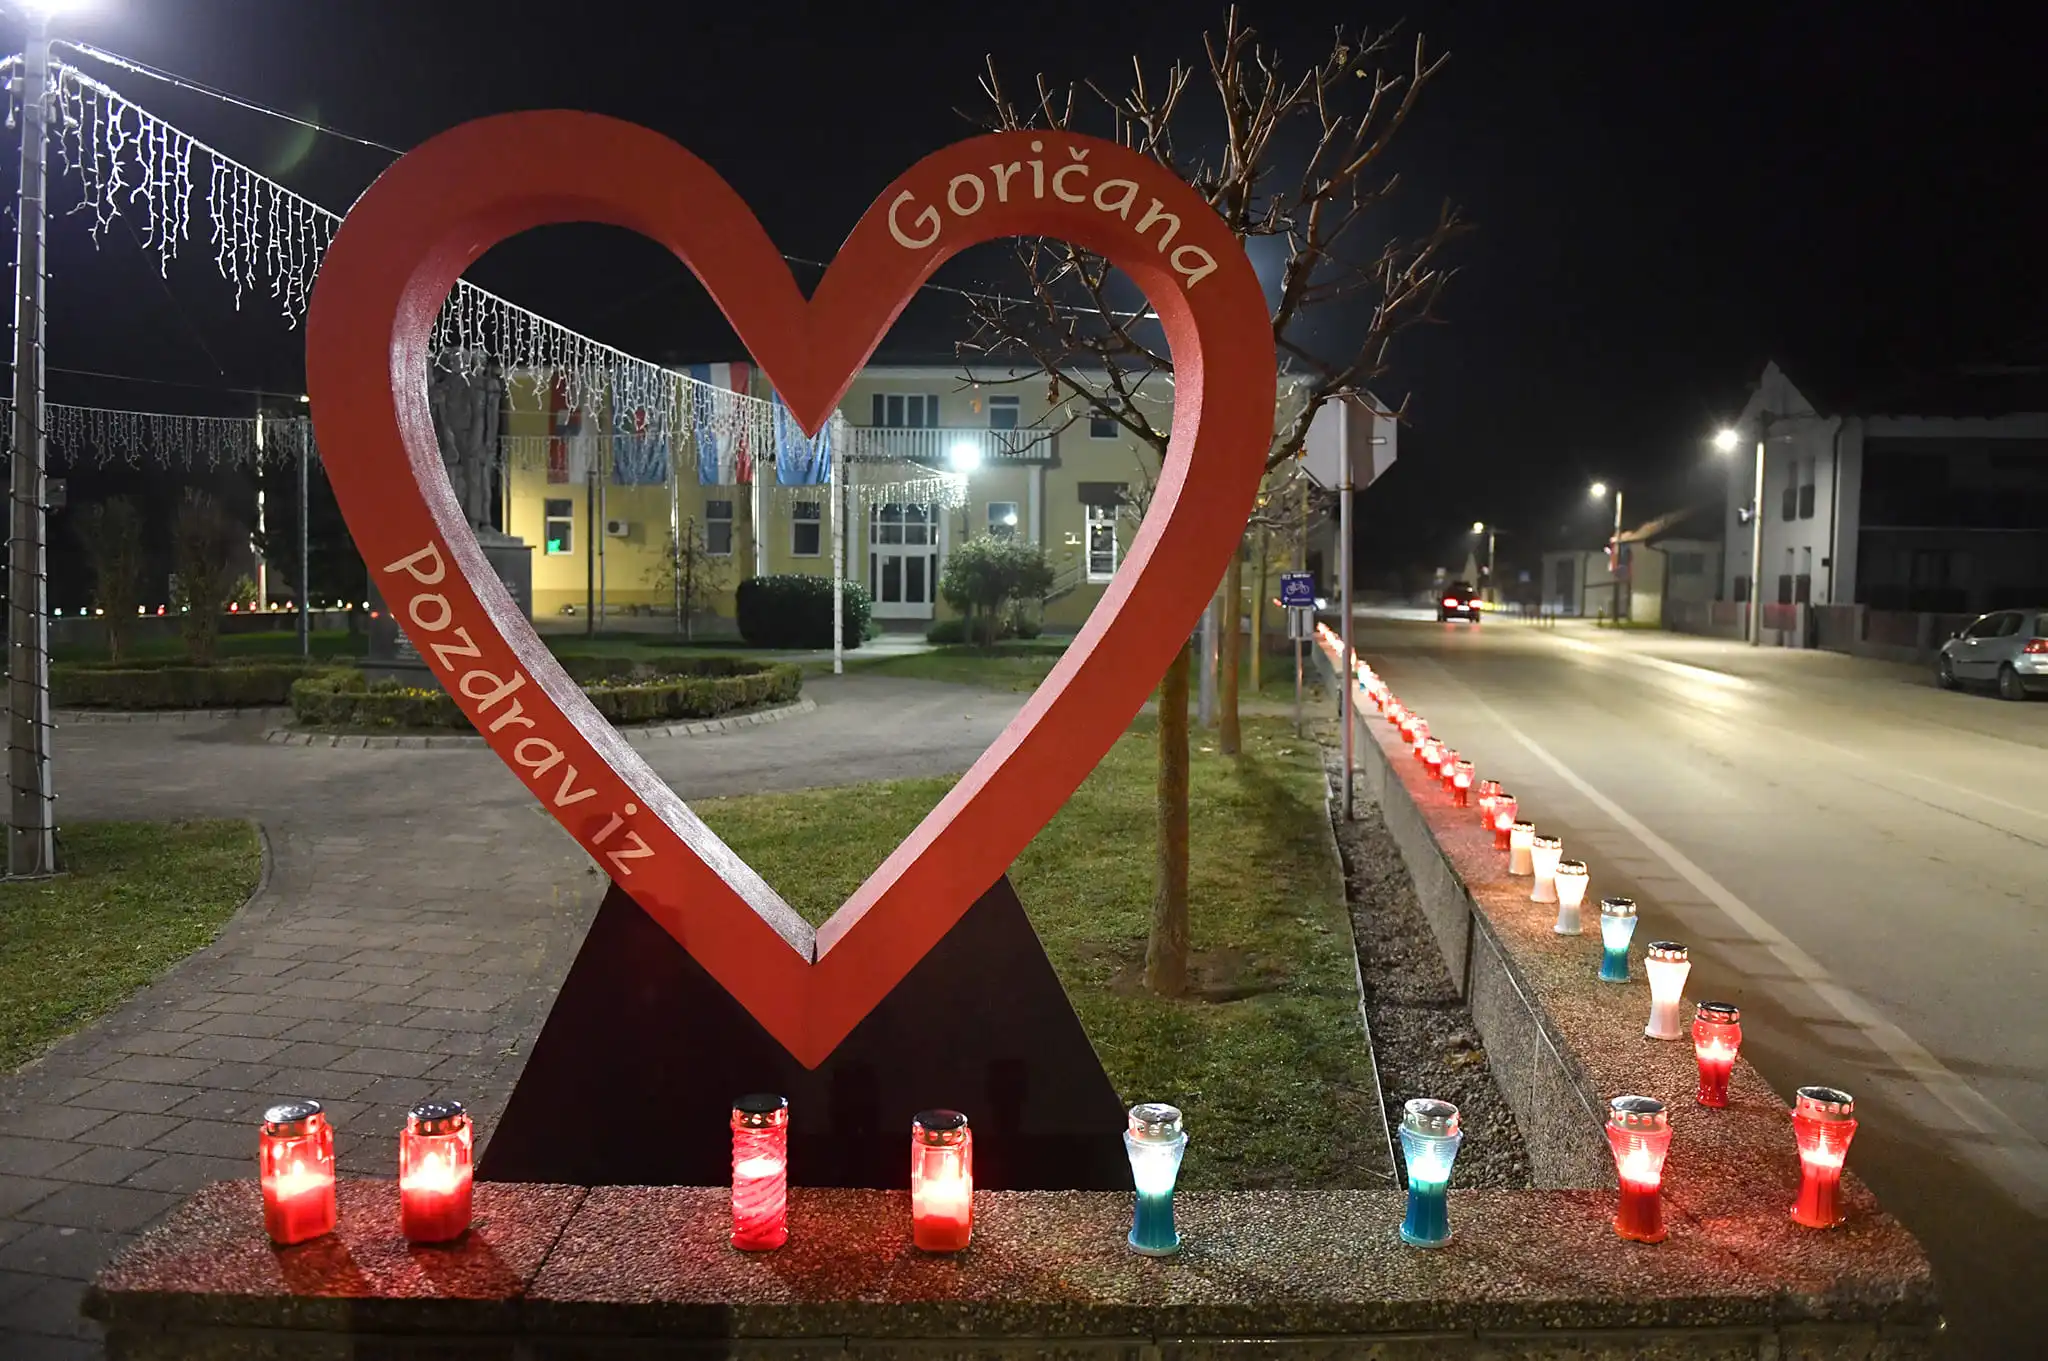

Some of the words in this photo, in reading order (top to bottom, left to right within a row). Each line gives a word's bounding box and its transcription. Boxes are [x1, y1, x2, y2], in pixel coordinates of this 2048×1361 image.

[888, 140, 1218, 289] Goričana
[383, 540, 598, 808] Pozdrav
[591, 802, 656, 876] iz
